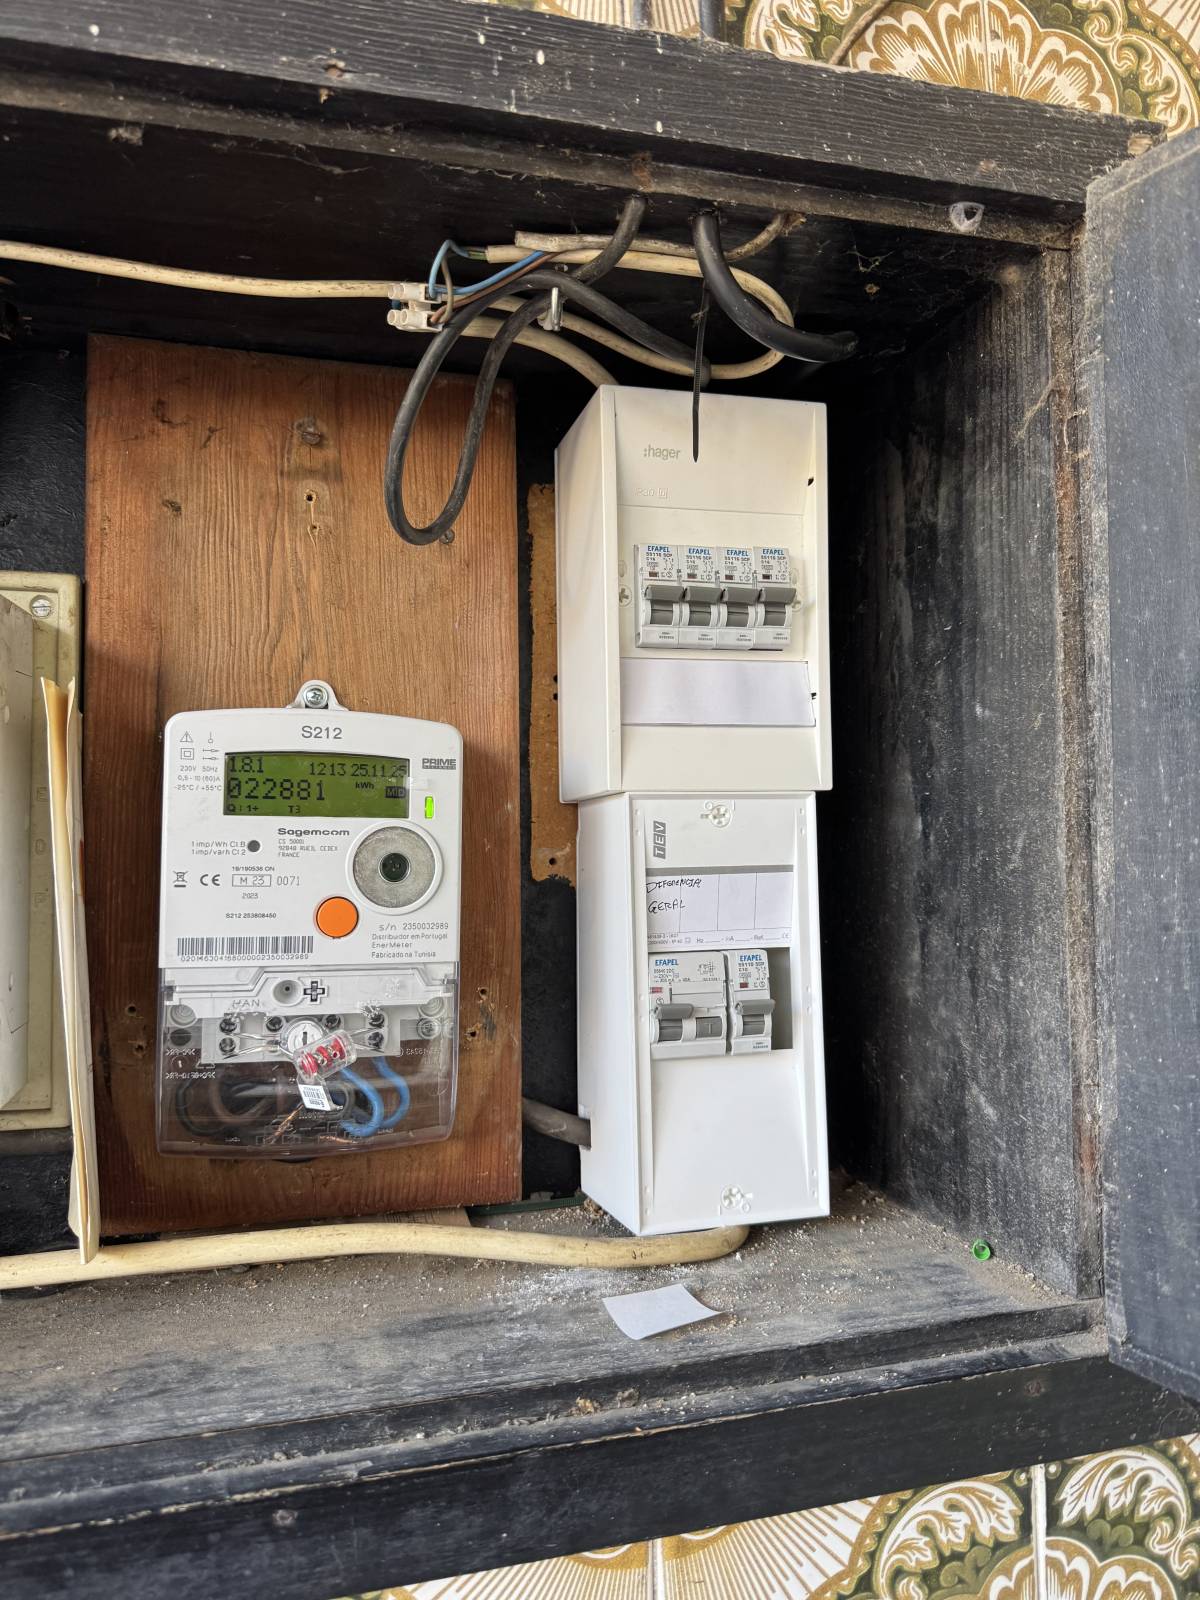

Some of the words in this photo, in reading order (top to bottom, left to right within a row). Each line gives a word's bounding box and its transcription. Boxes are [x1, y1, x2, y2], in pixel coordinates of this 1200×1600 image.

[647, 545, 671, 553] EFAPEL
[688, 547, 712, 556] EFAPEL
[726, 549, 749, 557] EFAPEL
[762, 548, 785, 556] EFAPEL
[301, 725, 343, 740] S212
[228, 777, 326, 801] 022881
[355, 781, 375, 790] kWh
[277, 827, 350, 838] Sagemcom
[653, 820, 667, 860] TEV
[252, 875, 266, 886] 23
[276, 875, 300, 887] 0071
[378, 923, 398, 932] s/n
[402, 922, 449, 930] 2350032989
[371, 933, 410, 941] Distribuidor
[420, 932, 449, 941] Portugal
[371, 951, 404, 959] Fabricado
[739, 954, 763, 962] EFAPEL
[655, 958, 679, 966] EFAPEL
[232, 999, 261, 1008] HAN
